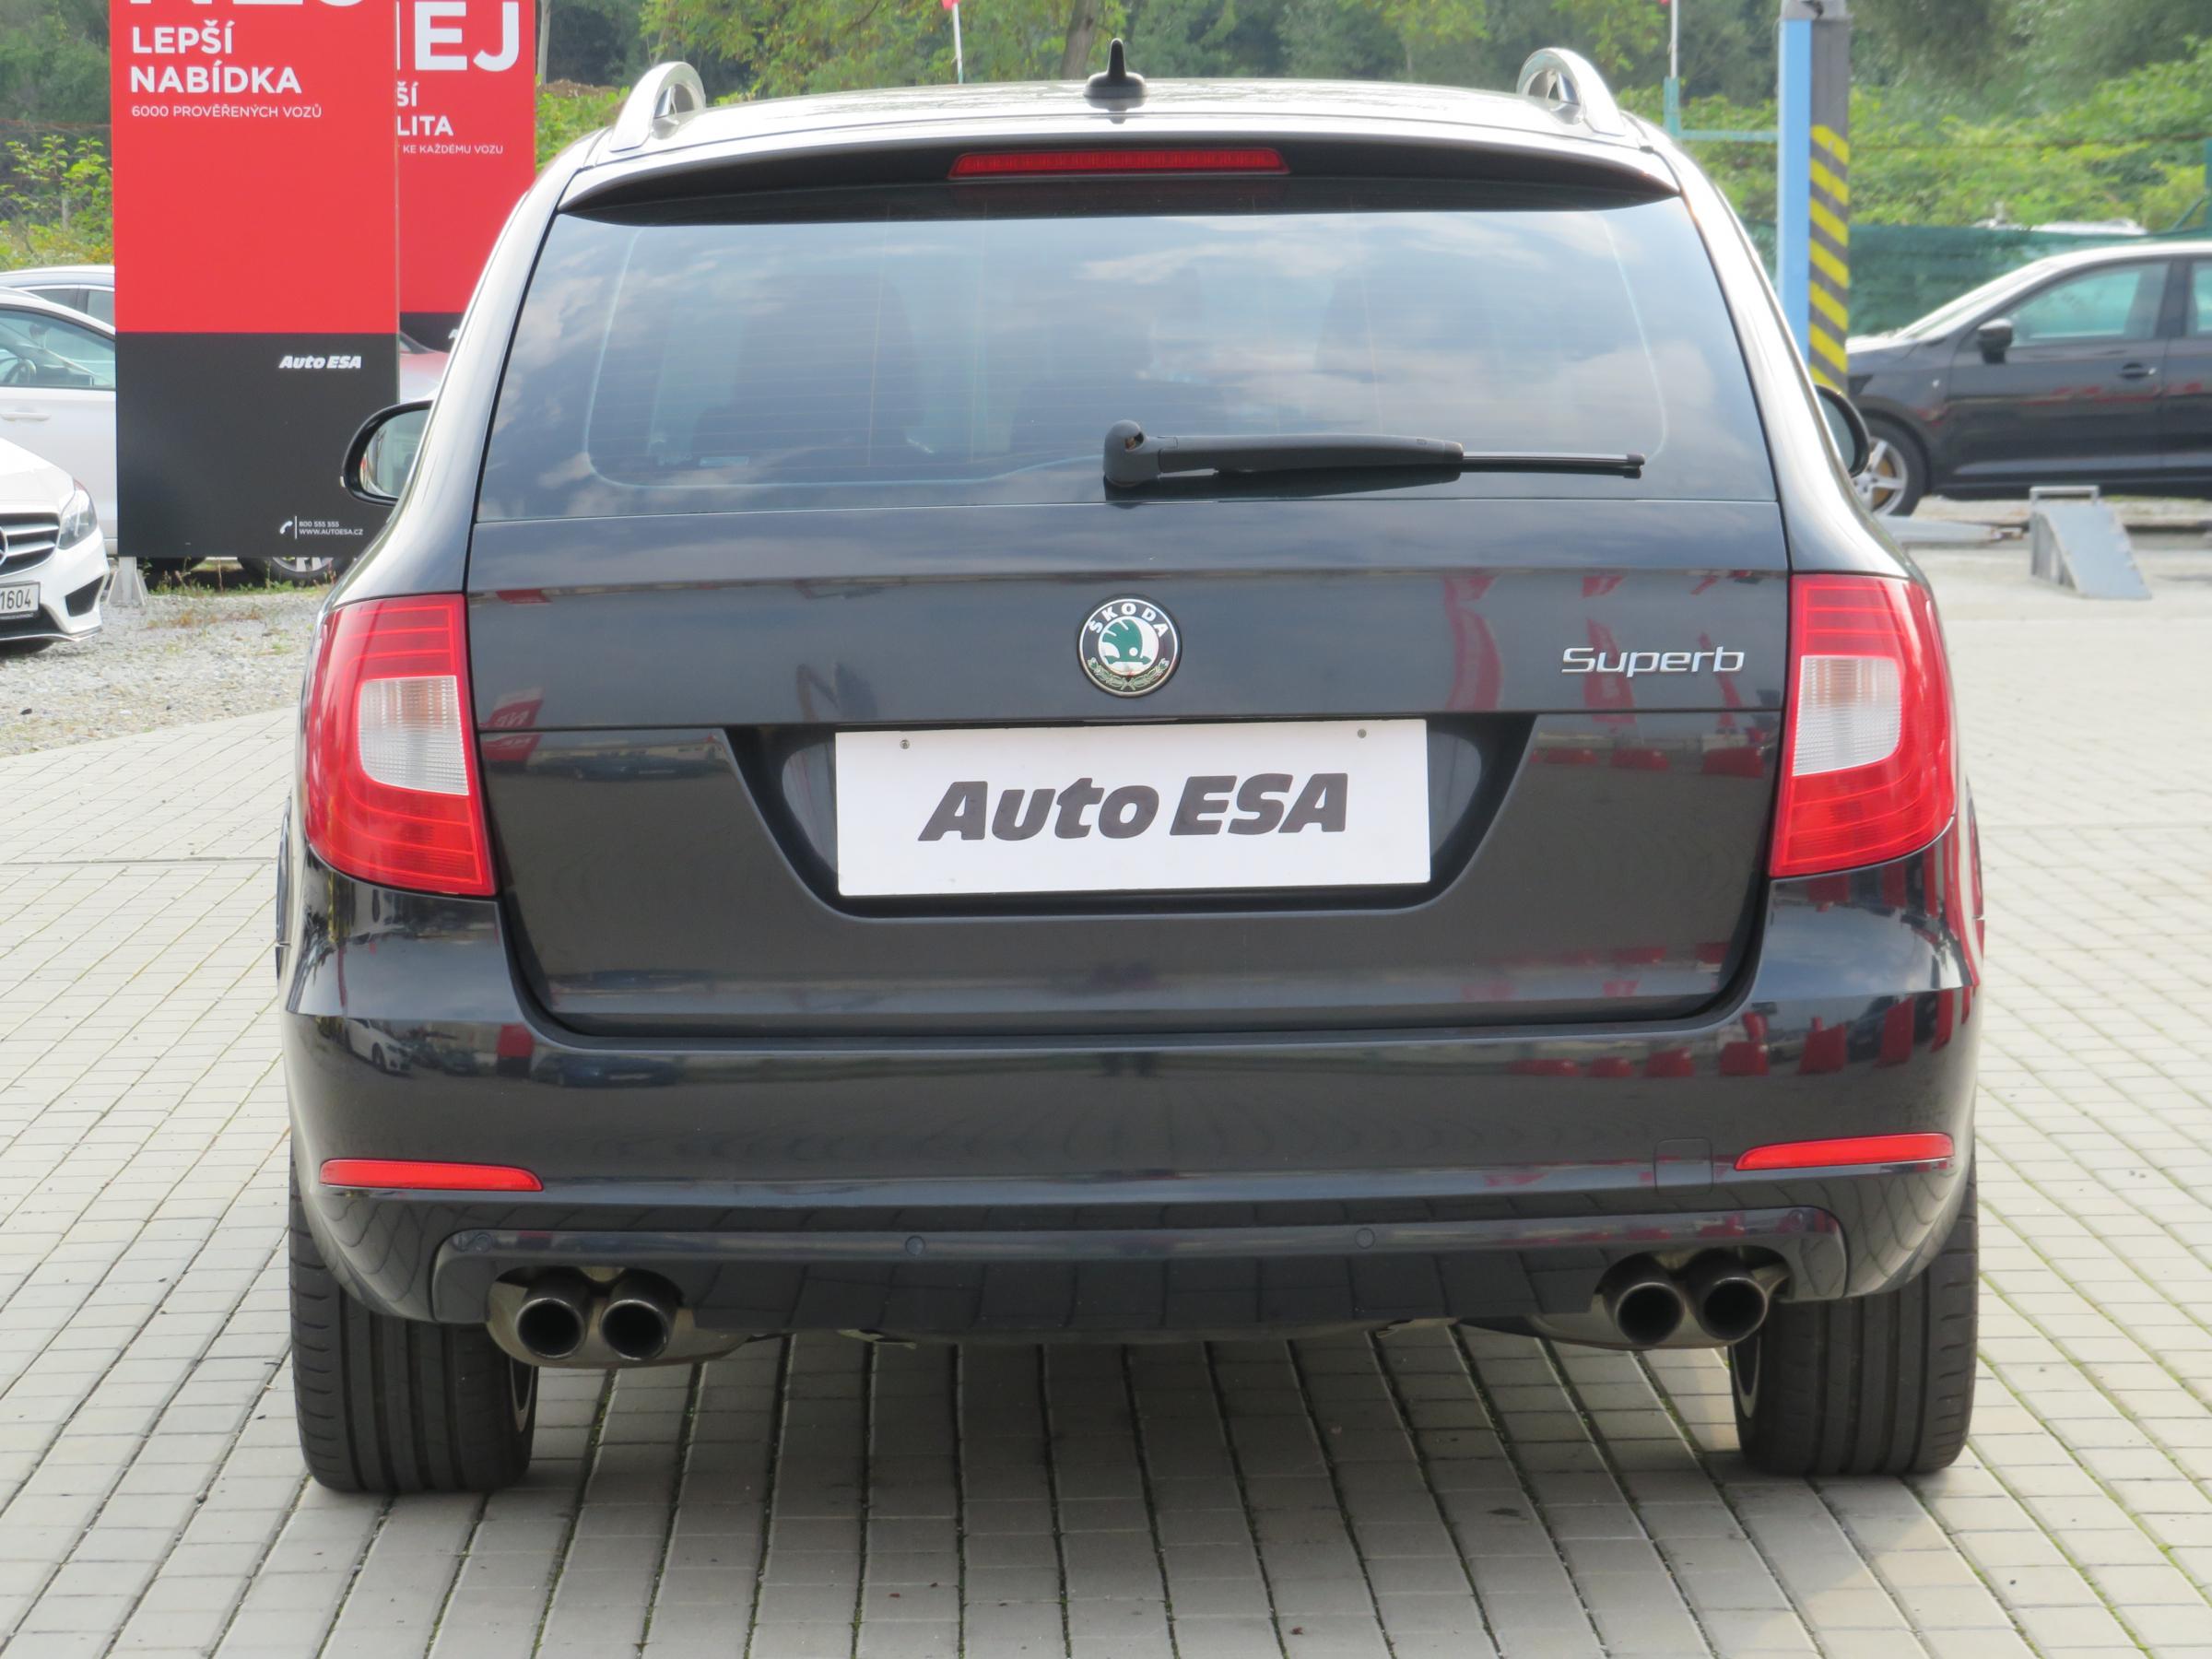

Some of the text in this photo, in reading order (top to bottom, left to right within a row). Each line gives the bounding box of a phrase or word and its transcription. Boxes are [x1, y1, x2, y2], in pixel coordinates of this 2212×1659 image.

[132, 18, 236, 54] LEPŠÍ
[396, 0, 520, 73] EJ
[130, 59, 303, 94] NABÍDKA
[131, 103, 323, 118] 6000 PROVĚŘENÝCH VOZŮ
[402, 142, 504, 155] KE KAŽDÉMU VOZU
[277, 355, 362, 370] Auto ESA
[0, 588, 32, 610] 1604
[1561, 646, 1745, 678] Superb
[917, 772, 1349, 841] Auto ESA
